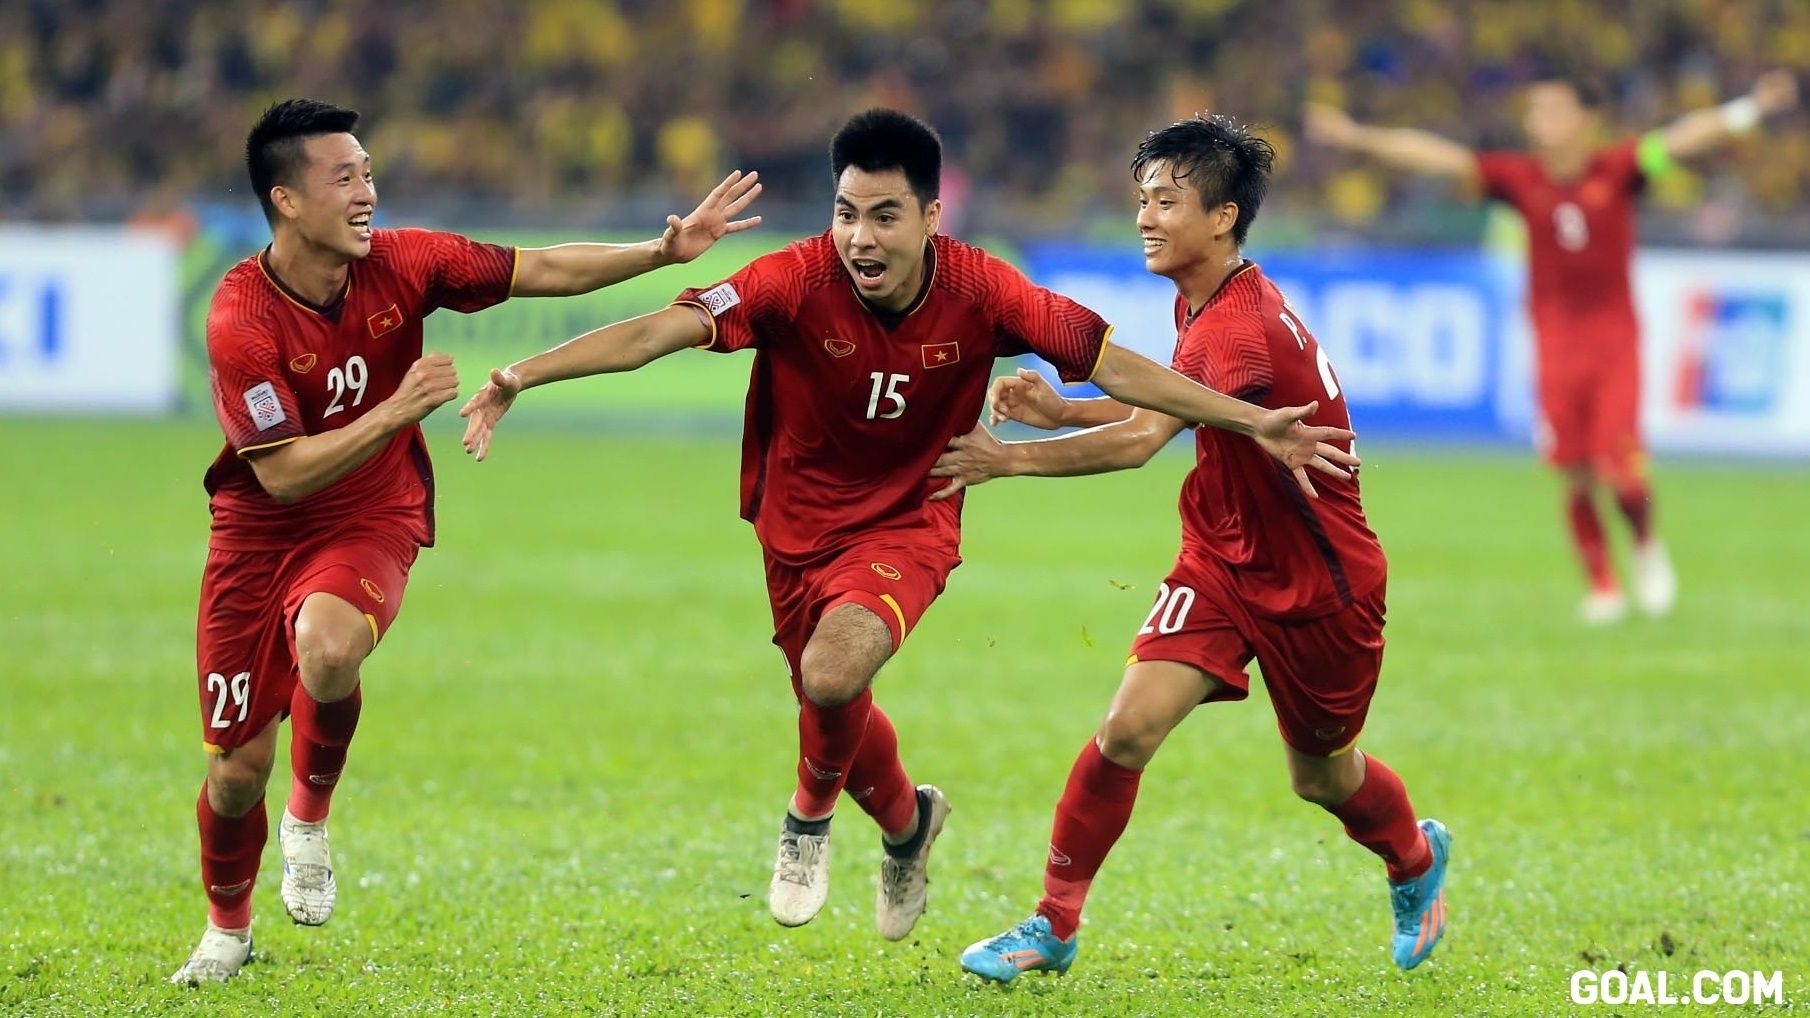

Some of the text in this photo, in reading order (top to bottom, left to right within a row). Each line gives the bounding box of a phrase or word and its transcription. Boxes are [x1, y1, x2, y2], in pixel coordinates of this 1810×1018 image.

[323, 355, 368, 419] 29
[866, 371, 910, 420] 15
[1138, 582, 1196, 635] 20
[207, 671, 251, 728] 29
